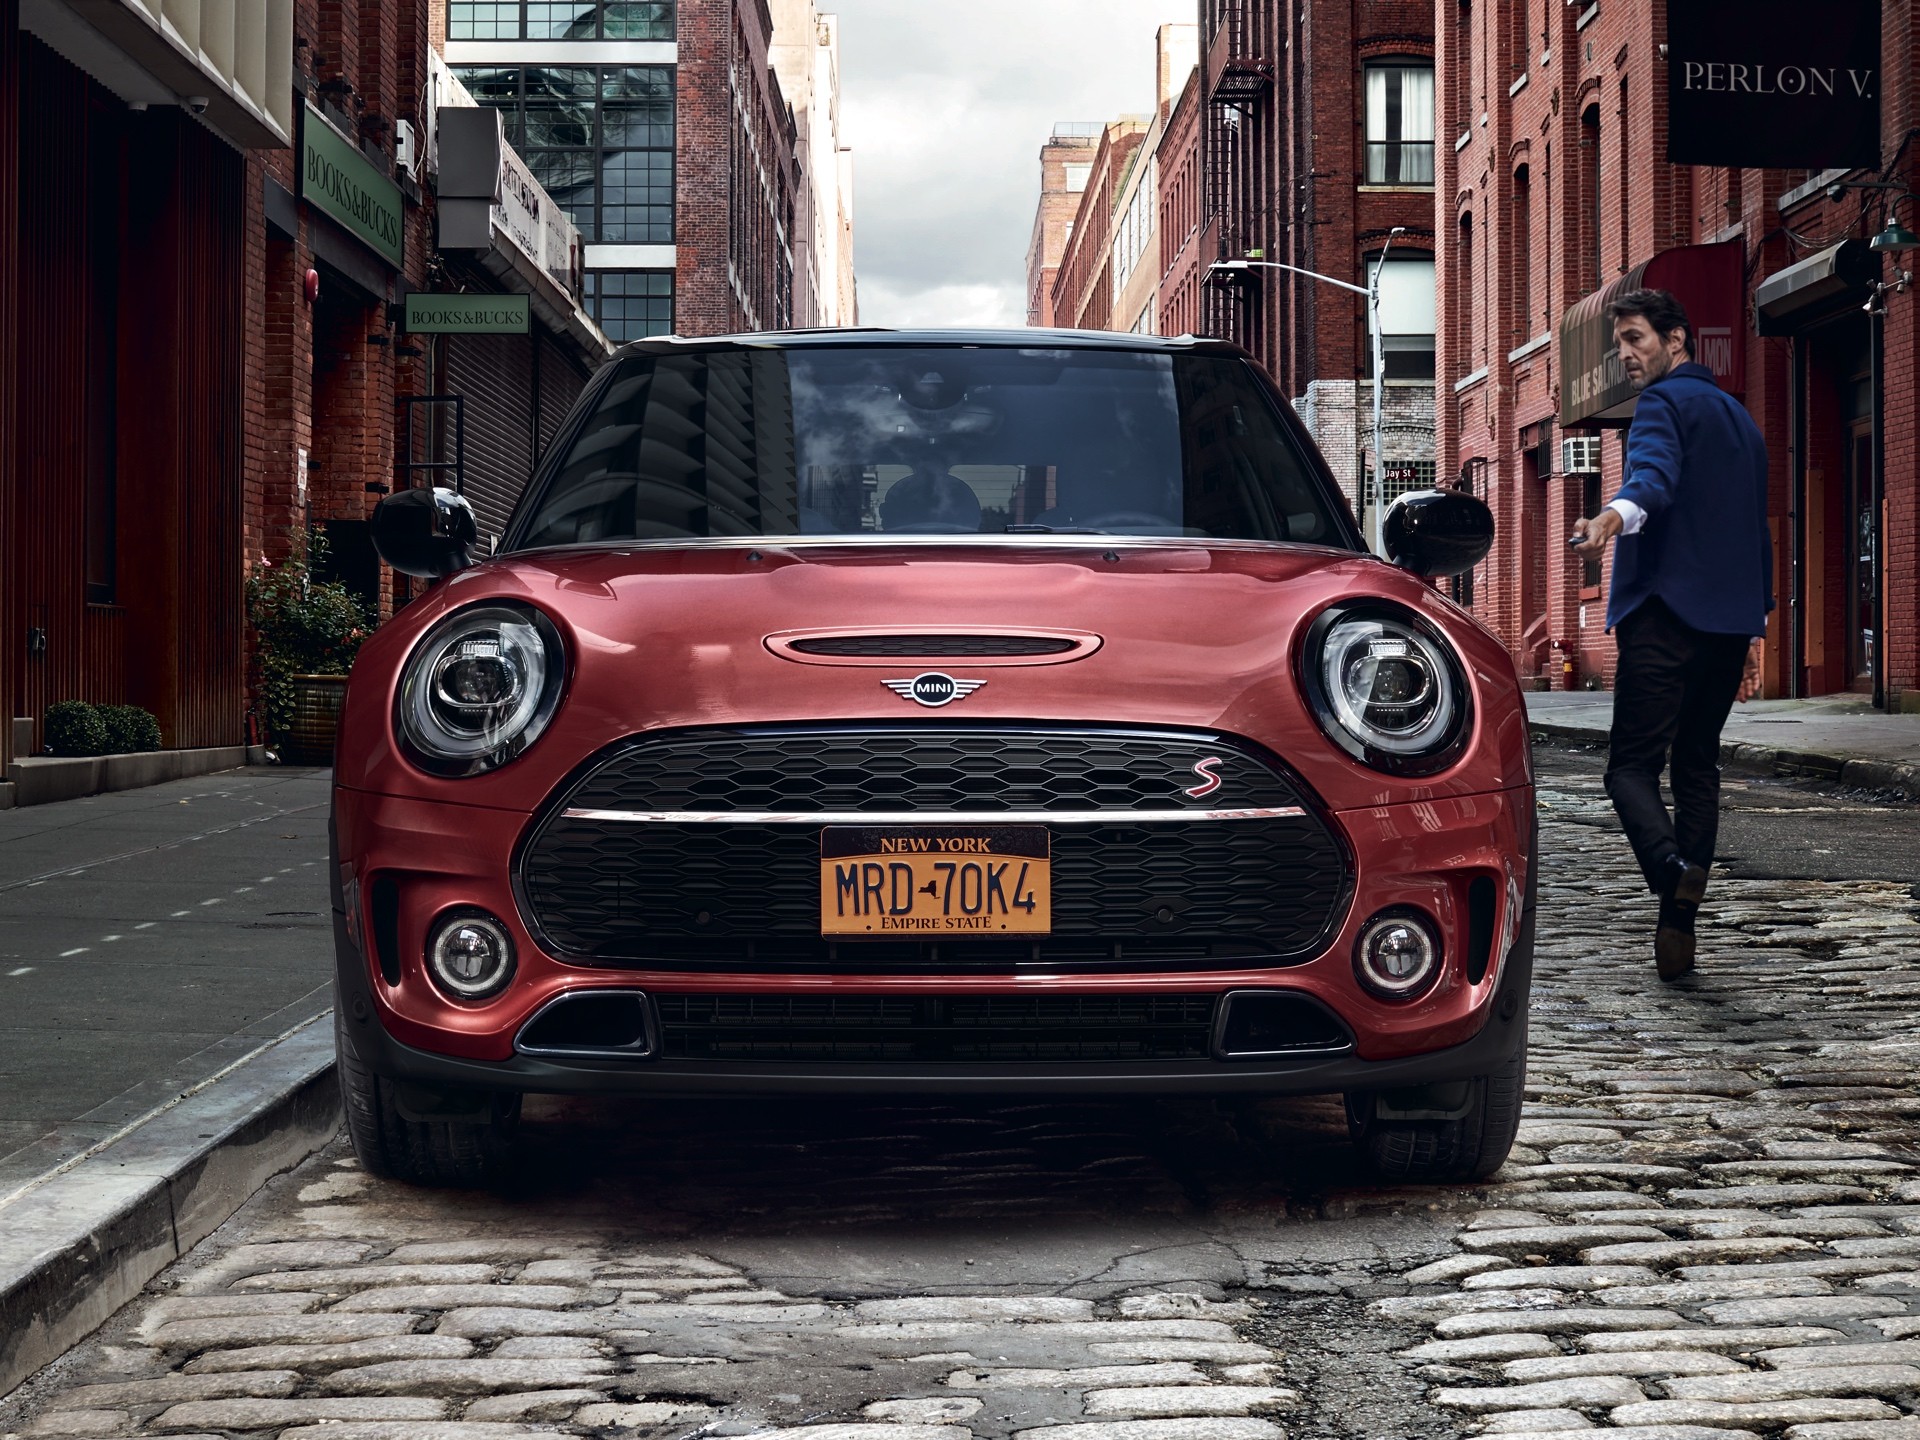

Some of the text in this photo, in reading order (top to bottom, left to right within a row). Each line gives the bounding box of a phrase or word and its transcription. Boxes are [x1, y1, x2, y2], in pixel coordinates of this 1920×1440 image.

[1847, 69, 1873, 99] V.
[1571, 371, 1591, 407] BLUE
[1386, 469, 1411, 479] Jay St
[916, 683, 951, 693] MINI
[1185, 756, 1222, 798] S
[880, 837, 991, 853] NEW YORK
[835, 862, 913, 916] MRD
[881, 916, 992, 929] EMPIRE STATE
